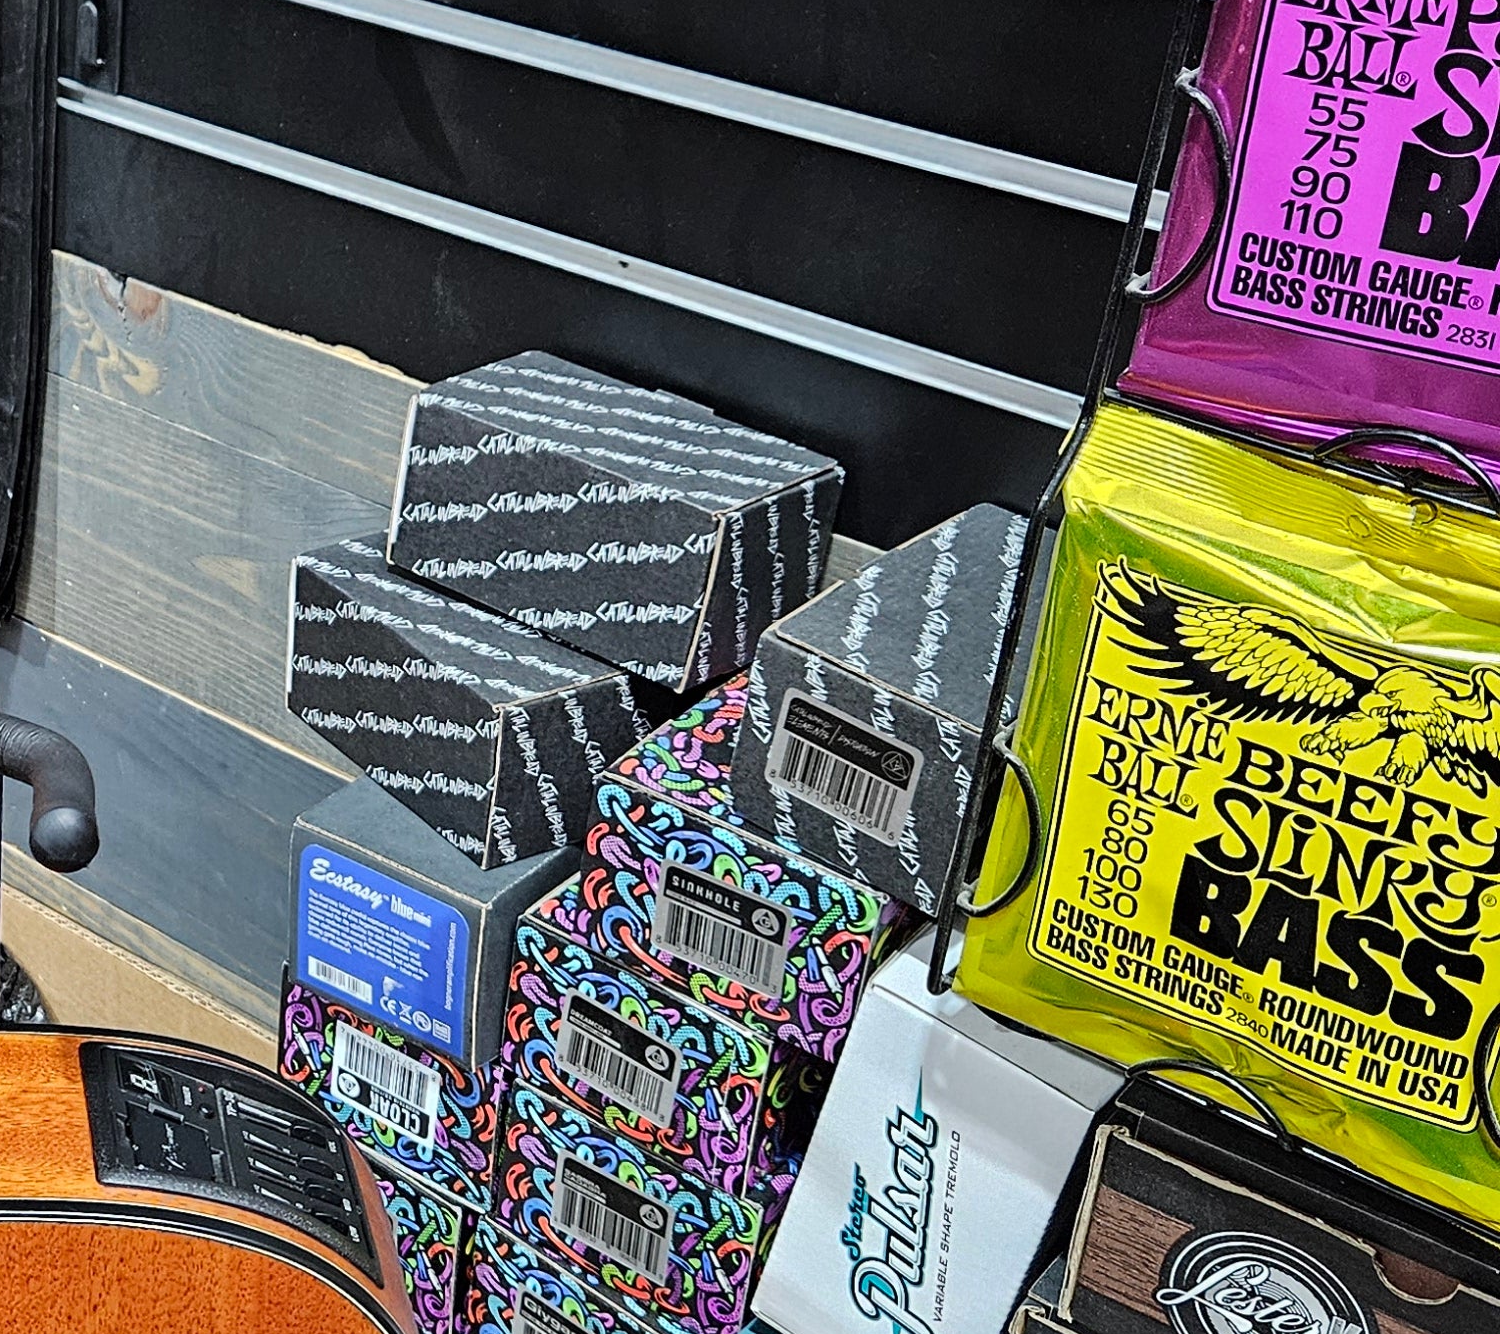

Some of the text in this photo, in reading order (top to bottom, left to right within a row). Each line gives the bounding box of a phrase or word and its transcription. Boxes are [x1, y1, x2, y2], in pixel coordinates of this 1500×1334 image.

[1308, 92, 1367, 134] 55
[1301, 130, 1359, 169] 75
[1291, 165, 1353, 205] 90
[1280, 199, 1344, 241] 110
[1238, 231, 1363, 286] CUSTOM
[1230, 268, 1303, 316] BASS
[1309, 281, 1443, 339] STRINGS
[402, 501, 489, 524] CATALINBREAD
[487, 491, 579, 514] CATALINBREAD
[411, 557, 496, 580] CATALINBREAD
[496, 548, 588, 572] CATALINBREAD
[587, 539, 685, 564] CATALINBREAD
[597, 603, 695, 626] CATALINBREAD
[301, 708, 357, 733] CATALINBREAD
[355, 710, 414, 738] CATALINBREAD
[413, 714, 477, 744] CATALINBREAD
[1084, 677, 1234, 765] ERNIE
[1108, 798, 1158, 838] 65
[1215, 736, 1500, 876] BEEFY
[1101, 831, 1150, 865] 80
[1082, 843, 1144, 894] 100
[390, 894, 414, 922] blue
[672, 875, 742, 913] SINKHOLE
[1077, 873, 1141, 921] 130
[1169, 850, 1484, 1042] BASS
[1052, 898, 1156, 963] CUSTOM
[1258, 988, 1471, 1081] ROUNDWOUND
[569, 1008, 613, 1037] DREAMCOAT
[1044, 923, 1461, 1111] BASS STRINGS 2840 MADE IN USA
[368, 1087, 422, 1134] CLOAK
[933, 1130, 963, 1324] VARIABLE SHAPE TREMOLO
